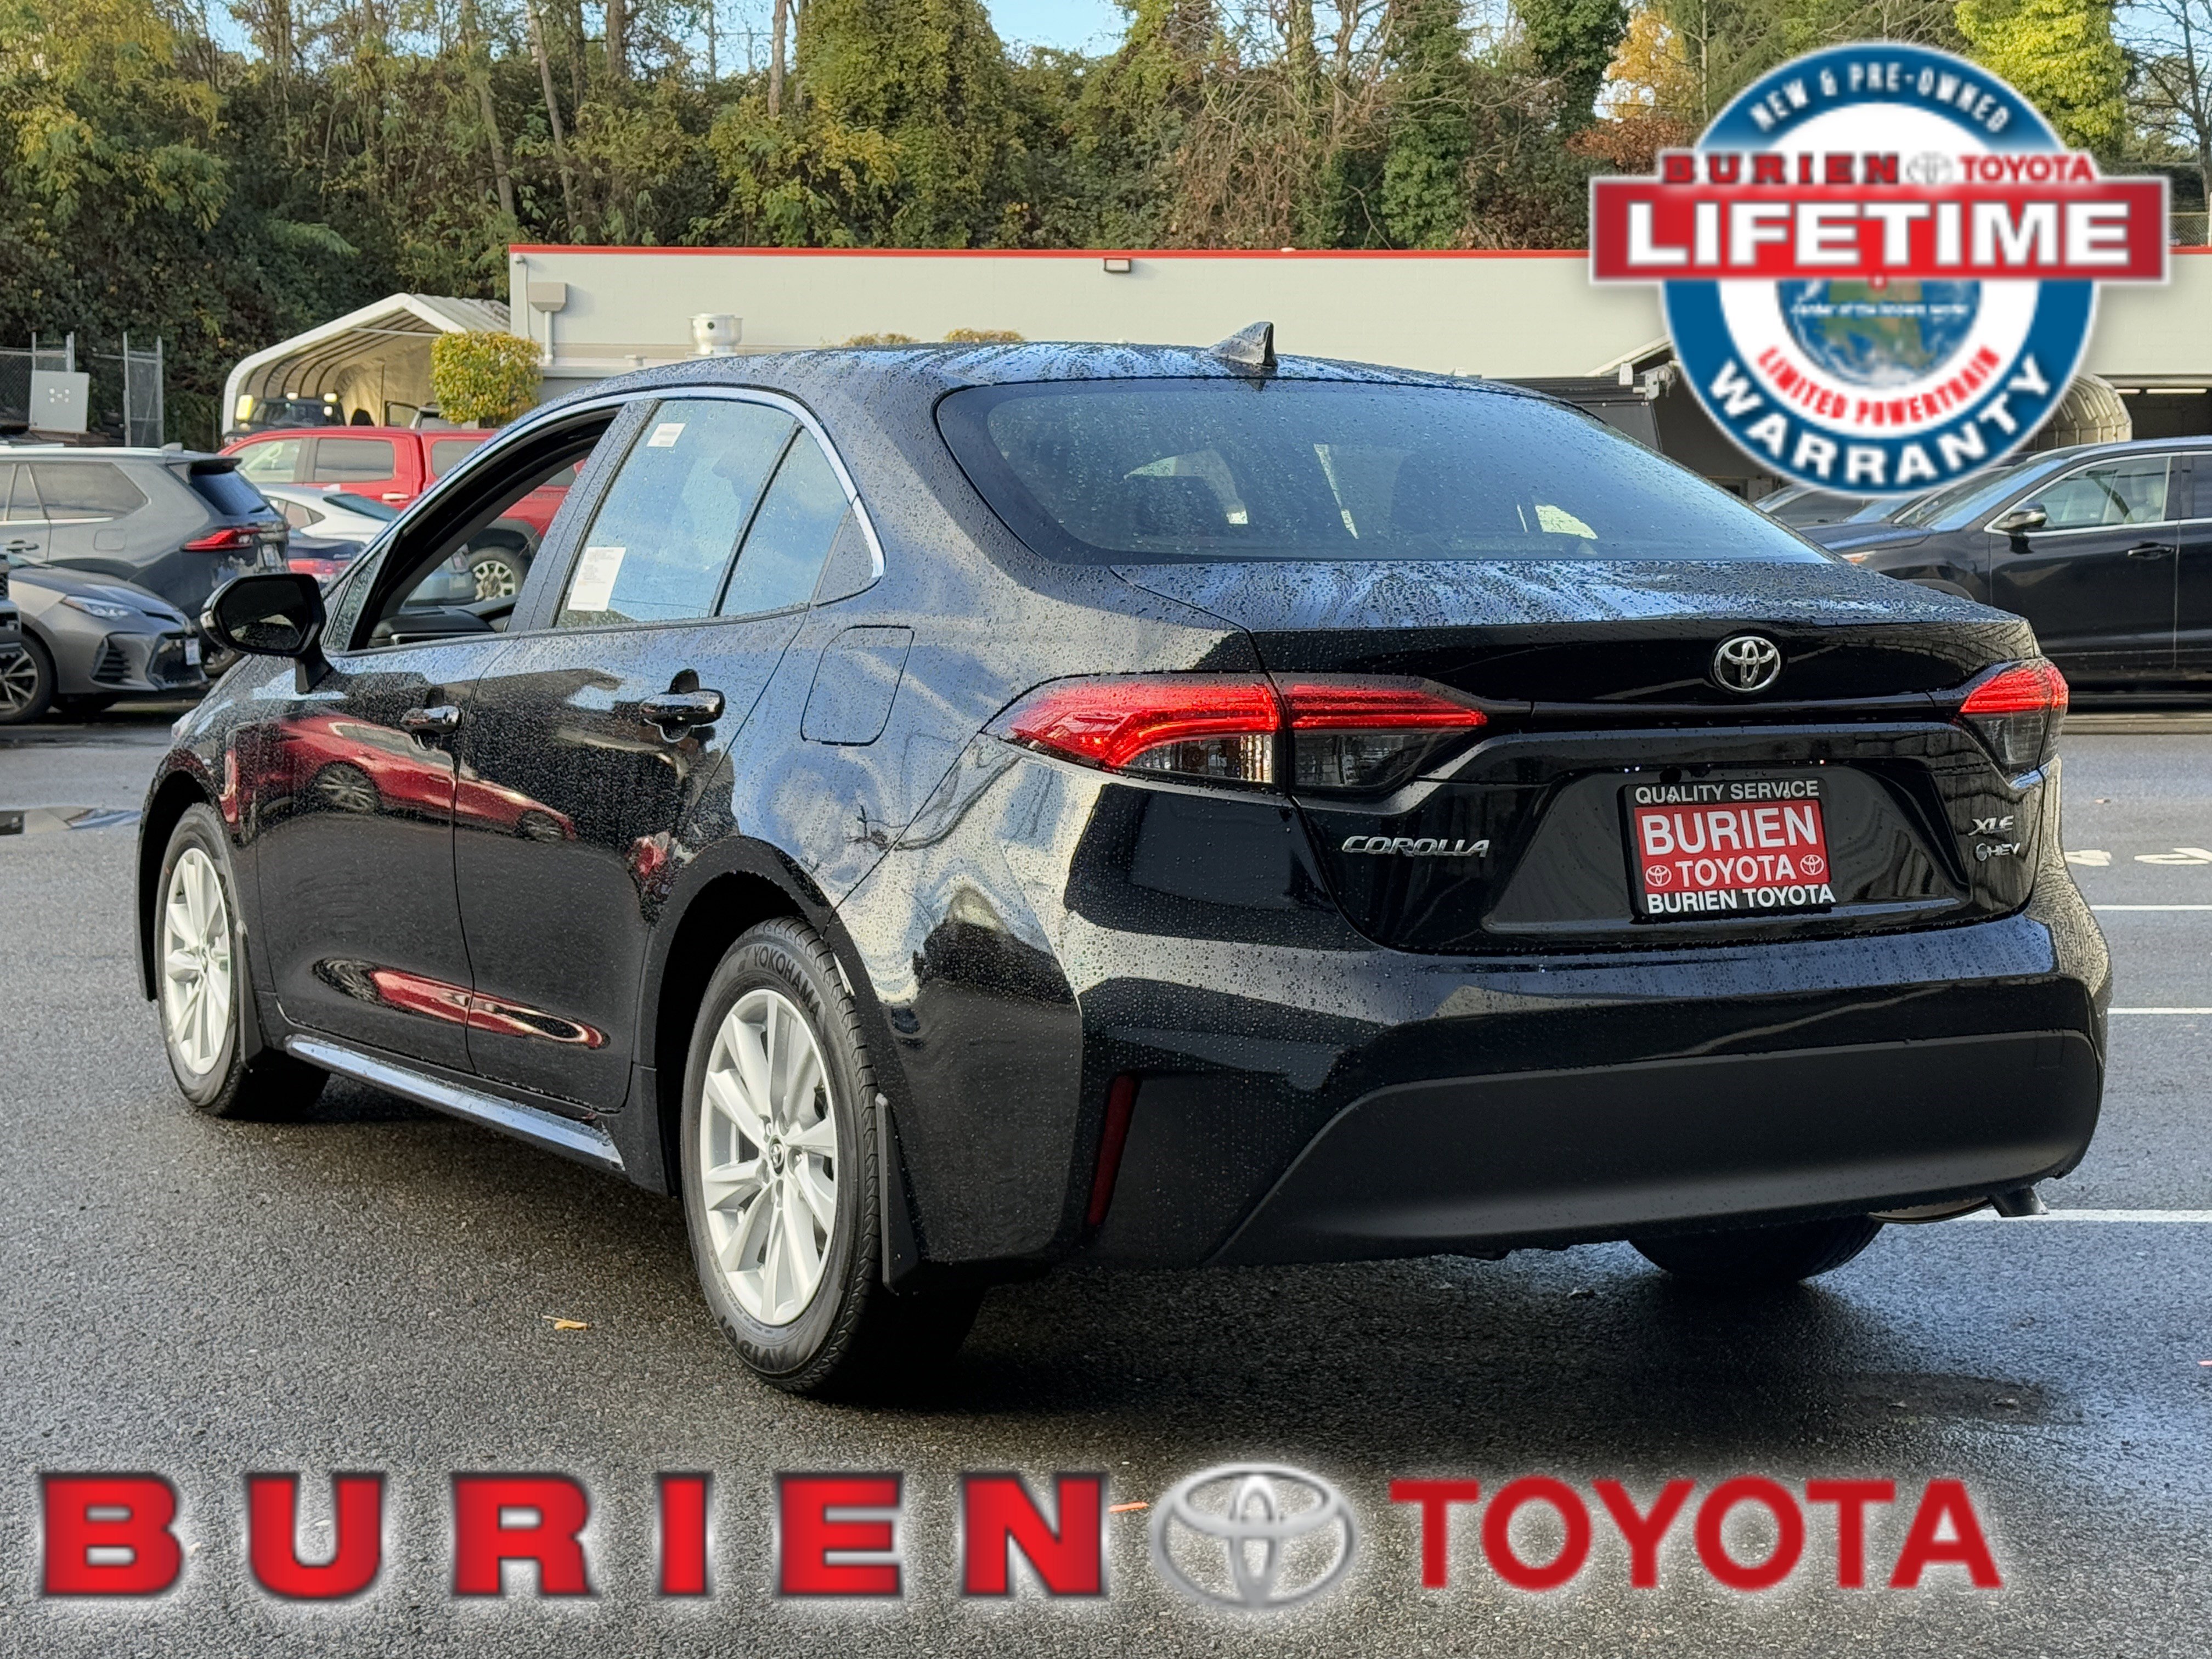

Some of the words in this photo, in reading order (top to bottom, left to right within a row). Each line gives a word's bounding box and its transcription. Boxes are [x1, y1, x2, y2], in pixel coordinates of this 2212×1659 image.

[1635, 784, 1724, 804] QUALITY
[1730, 780, 1820, 800] SERVICE
[1641, 805, 1818, 856] BURIEN
[1968, 815, 2015, 836] XLE
[1342, 836, 1490, 857] COROLLA
[1675, 854, 1797, 888] TOYOTA
[1646, 891, 1738, 915] BURIEN
[1742, 884, 1837, 909] TOYOTA
[754, 946, 821, 1023] YOKOHAMA
